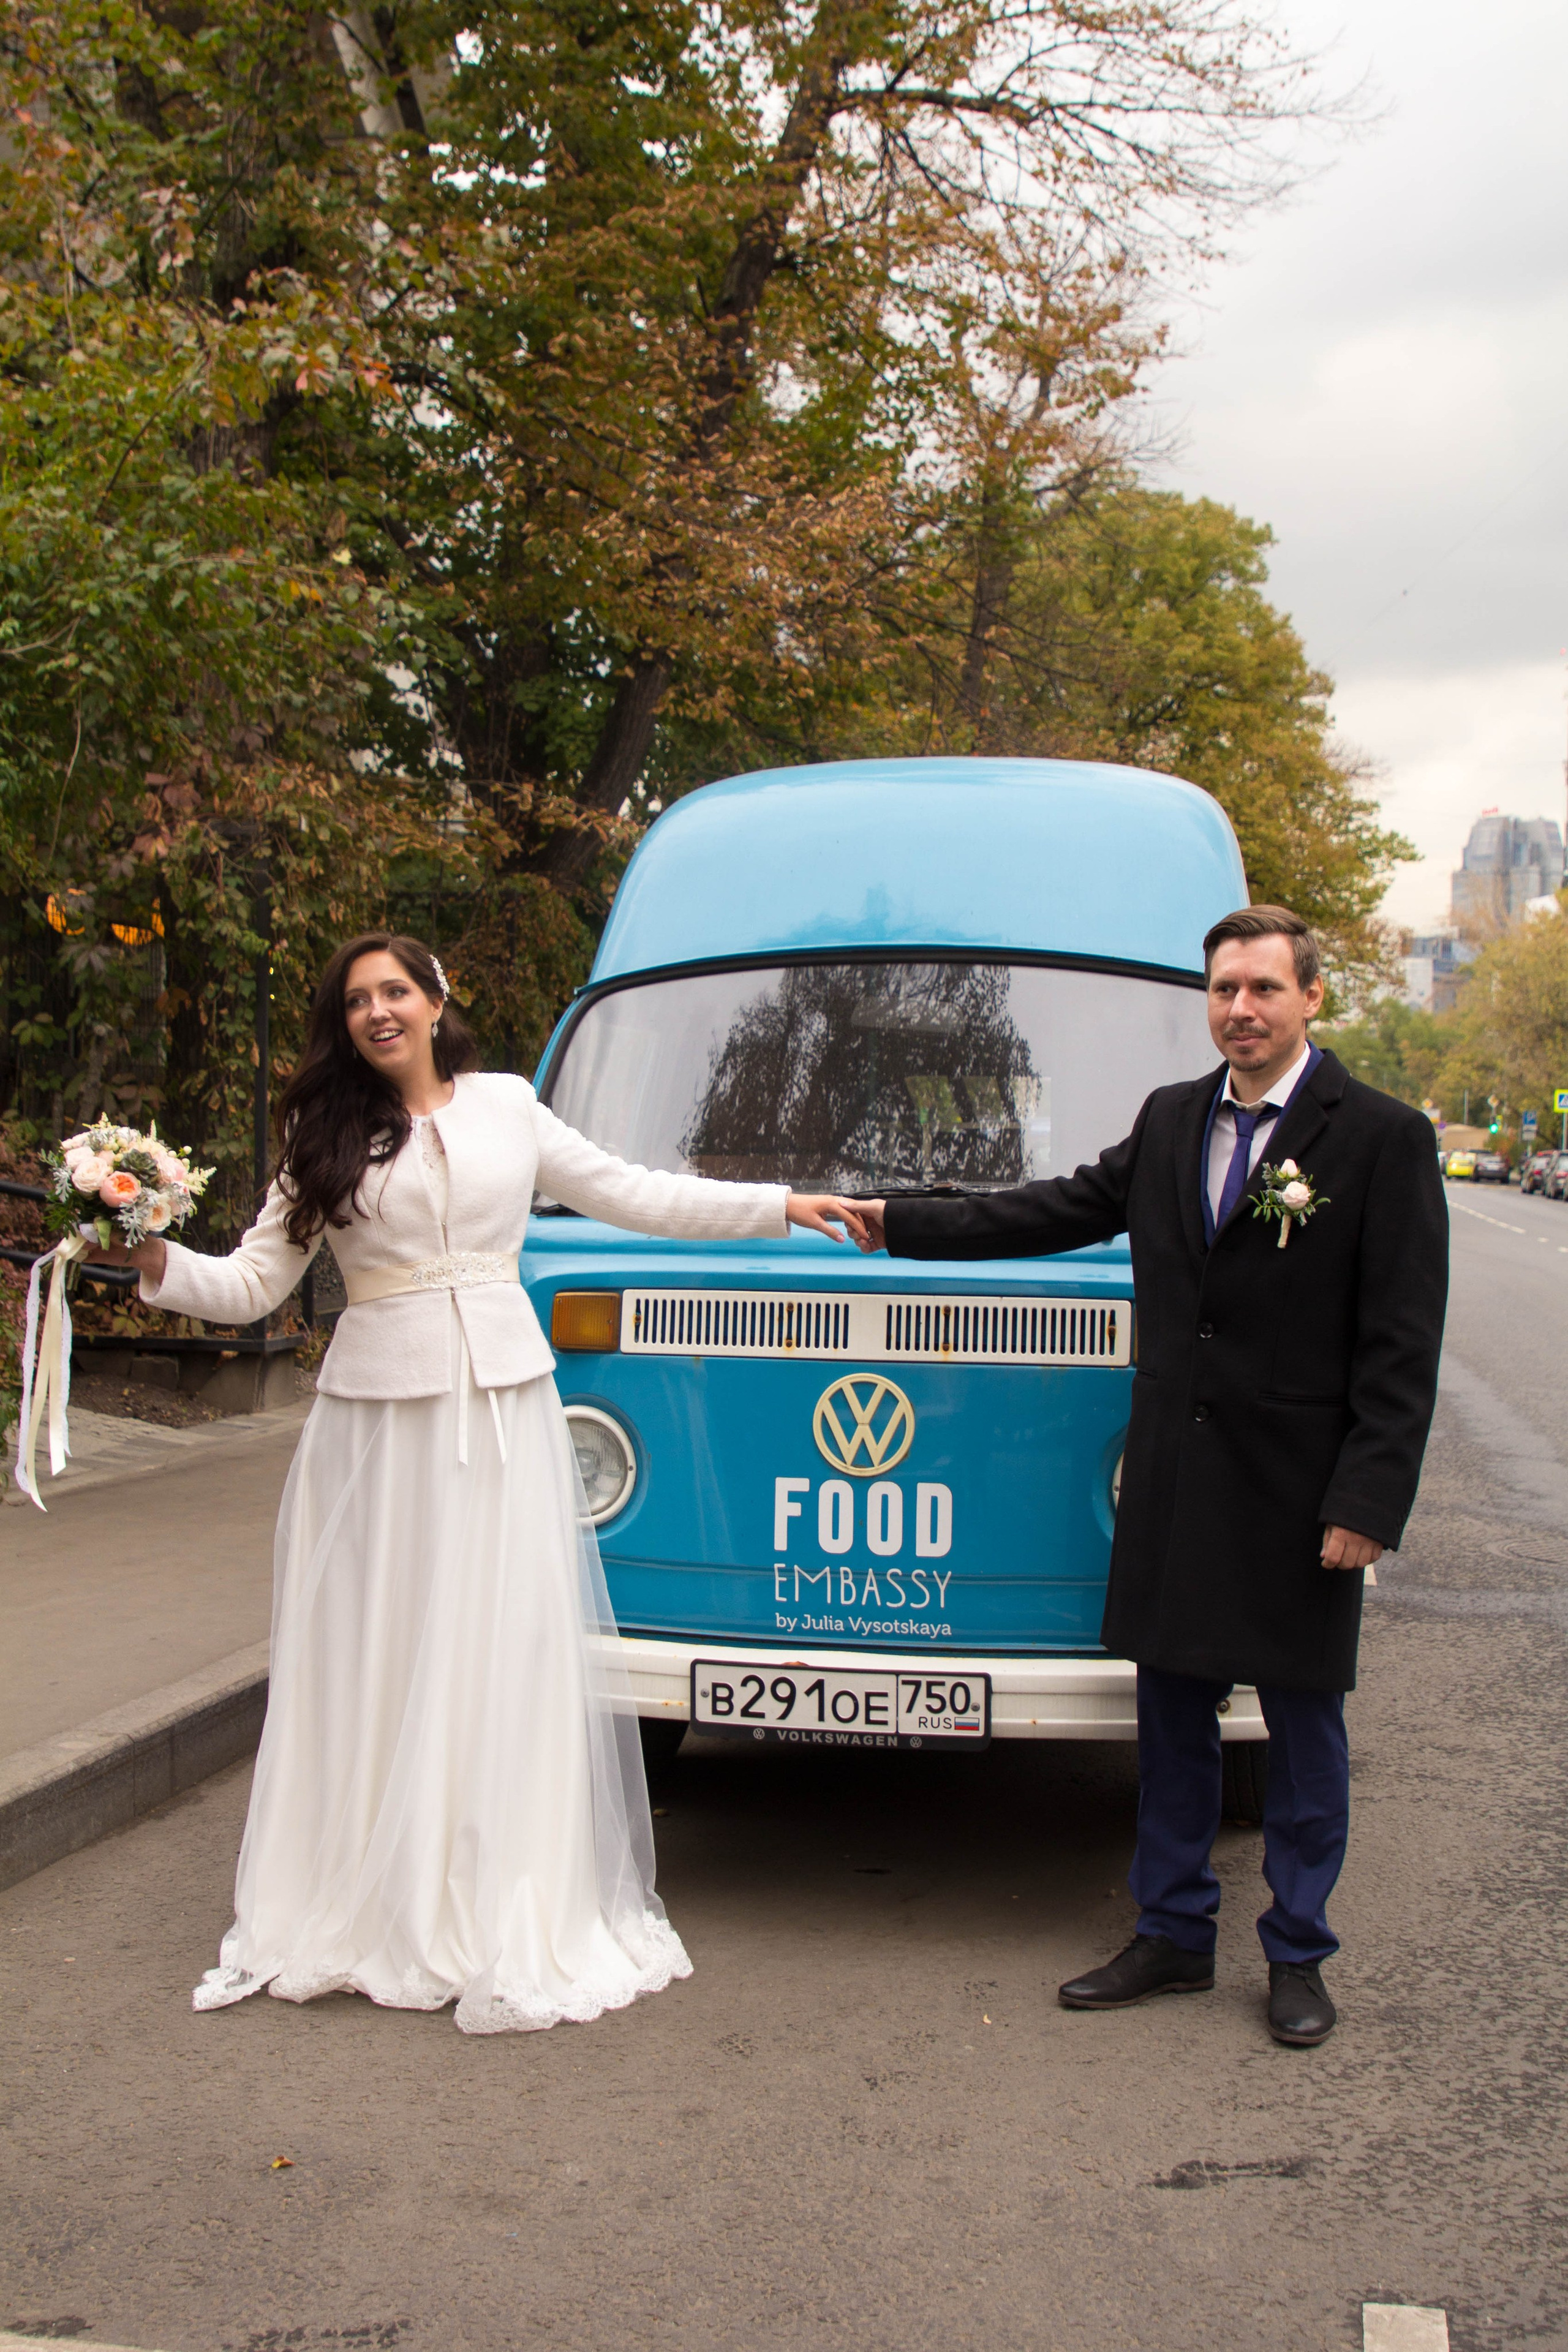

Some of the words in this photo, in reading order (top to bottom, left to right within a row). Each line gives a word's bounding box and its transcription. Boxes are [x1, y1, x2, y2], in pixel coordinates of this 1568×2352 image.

[774, 1477, 953, 1558] FOOD
[774, 1562, 952, 1608] EMBASSY
[775, 1612, 798, 1632] by
[801, 1614, 845, 1632] Julia
[848, 1616, 952, 1639] Vysotskaya
[901, 1679, 971, 1715] 750
[777, 1729, 898, 1747] VOLKSWAGEN
[918, 1716, 952, 1730] RUS
